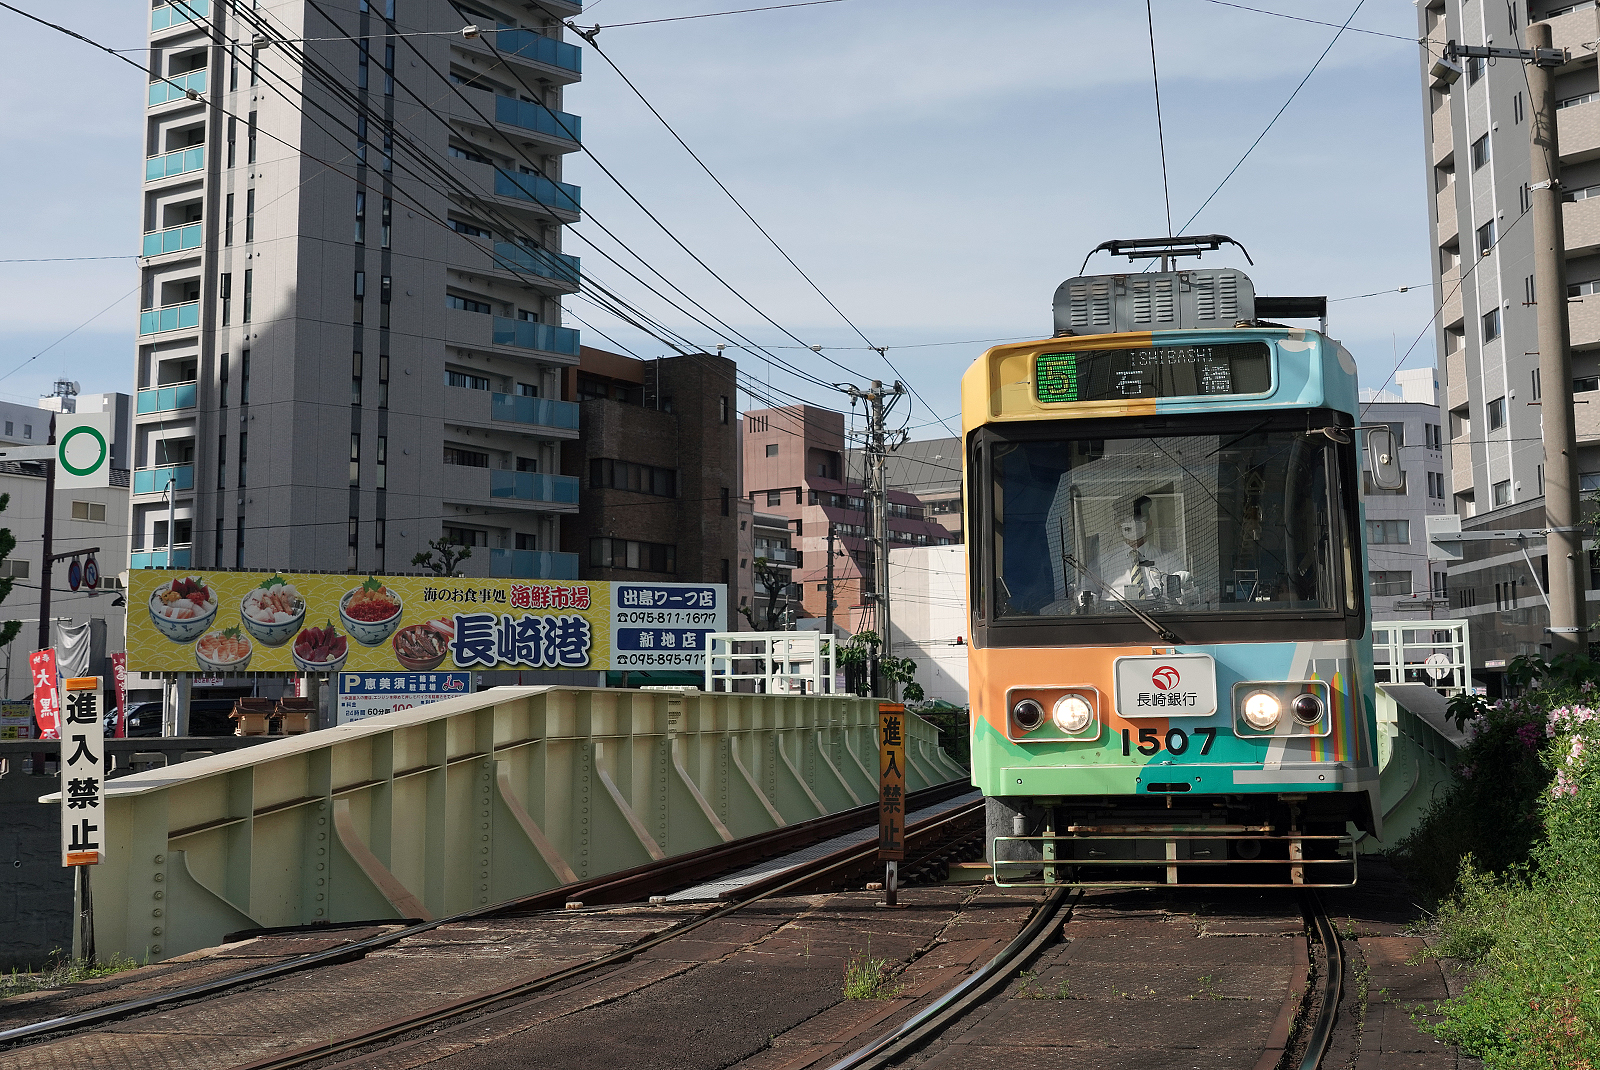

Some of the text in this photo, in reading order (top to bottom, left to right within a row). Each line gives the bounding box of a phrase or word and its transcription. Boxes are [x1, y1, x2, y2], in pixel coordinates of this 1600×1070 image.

[1130, 347, 1213, 367] ISHIBASHI
[1046, 360, 1069, 396] 5
[423, 584, 591, 609] 海のお食事処 海鮮市場
[623, 589, 714, 607] 出島ワーフ店
[629, 611, 717, 624] 095-811-1677
[449, 612, 591, 667] 長崎港
[639, 631, 697, 648] 新地店
[344, 674, 361, 693] P
[364, 677, 406, 690] 恵美須
[409, 675, 437, 683] 二輪車
[1136, 692, 1198, 707] 長崎銀行
[1121, 727, 1217, 757] 1507
[66, 692, 99, 851] 進入禁止
[882, 715, 902, 849] 進入禁止
